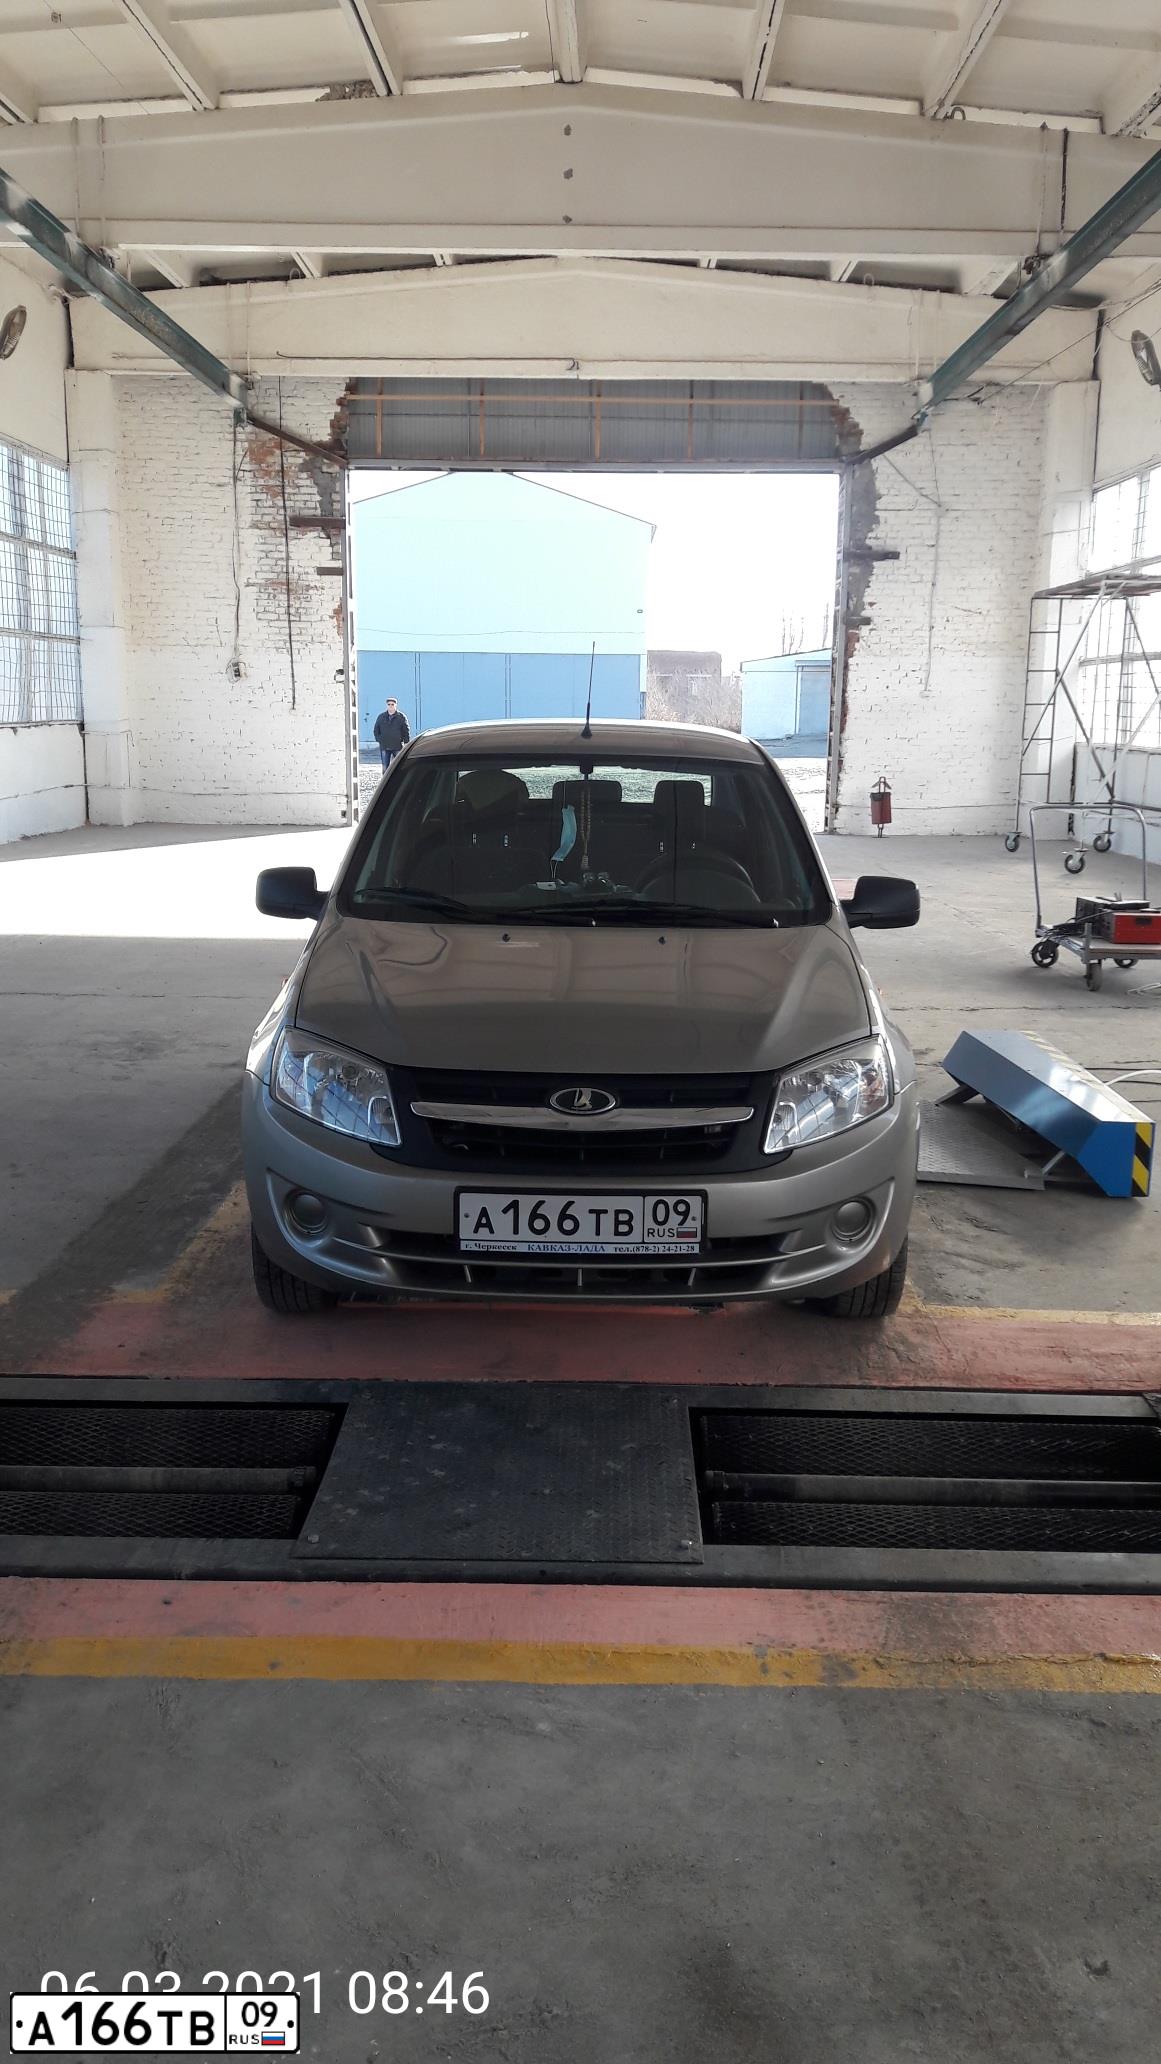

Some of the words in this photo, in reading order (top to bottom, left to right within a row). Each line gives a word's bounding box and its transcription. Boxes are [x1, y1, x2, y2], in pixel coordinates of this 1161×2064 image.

[652, 1198, 691, 1226] 09
[647, 1227, 675, 1238] RUS
[474, 1243, 517, 1252] Черкесск
[527, 1244, 606, 1253] КАВКАЗ-ЛАДА
